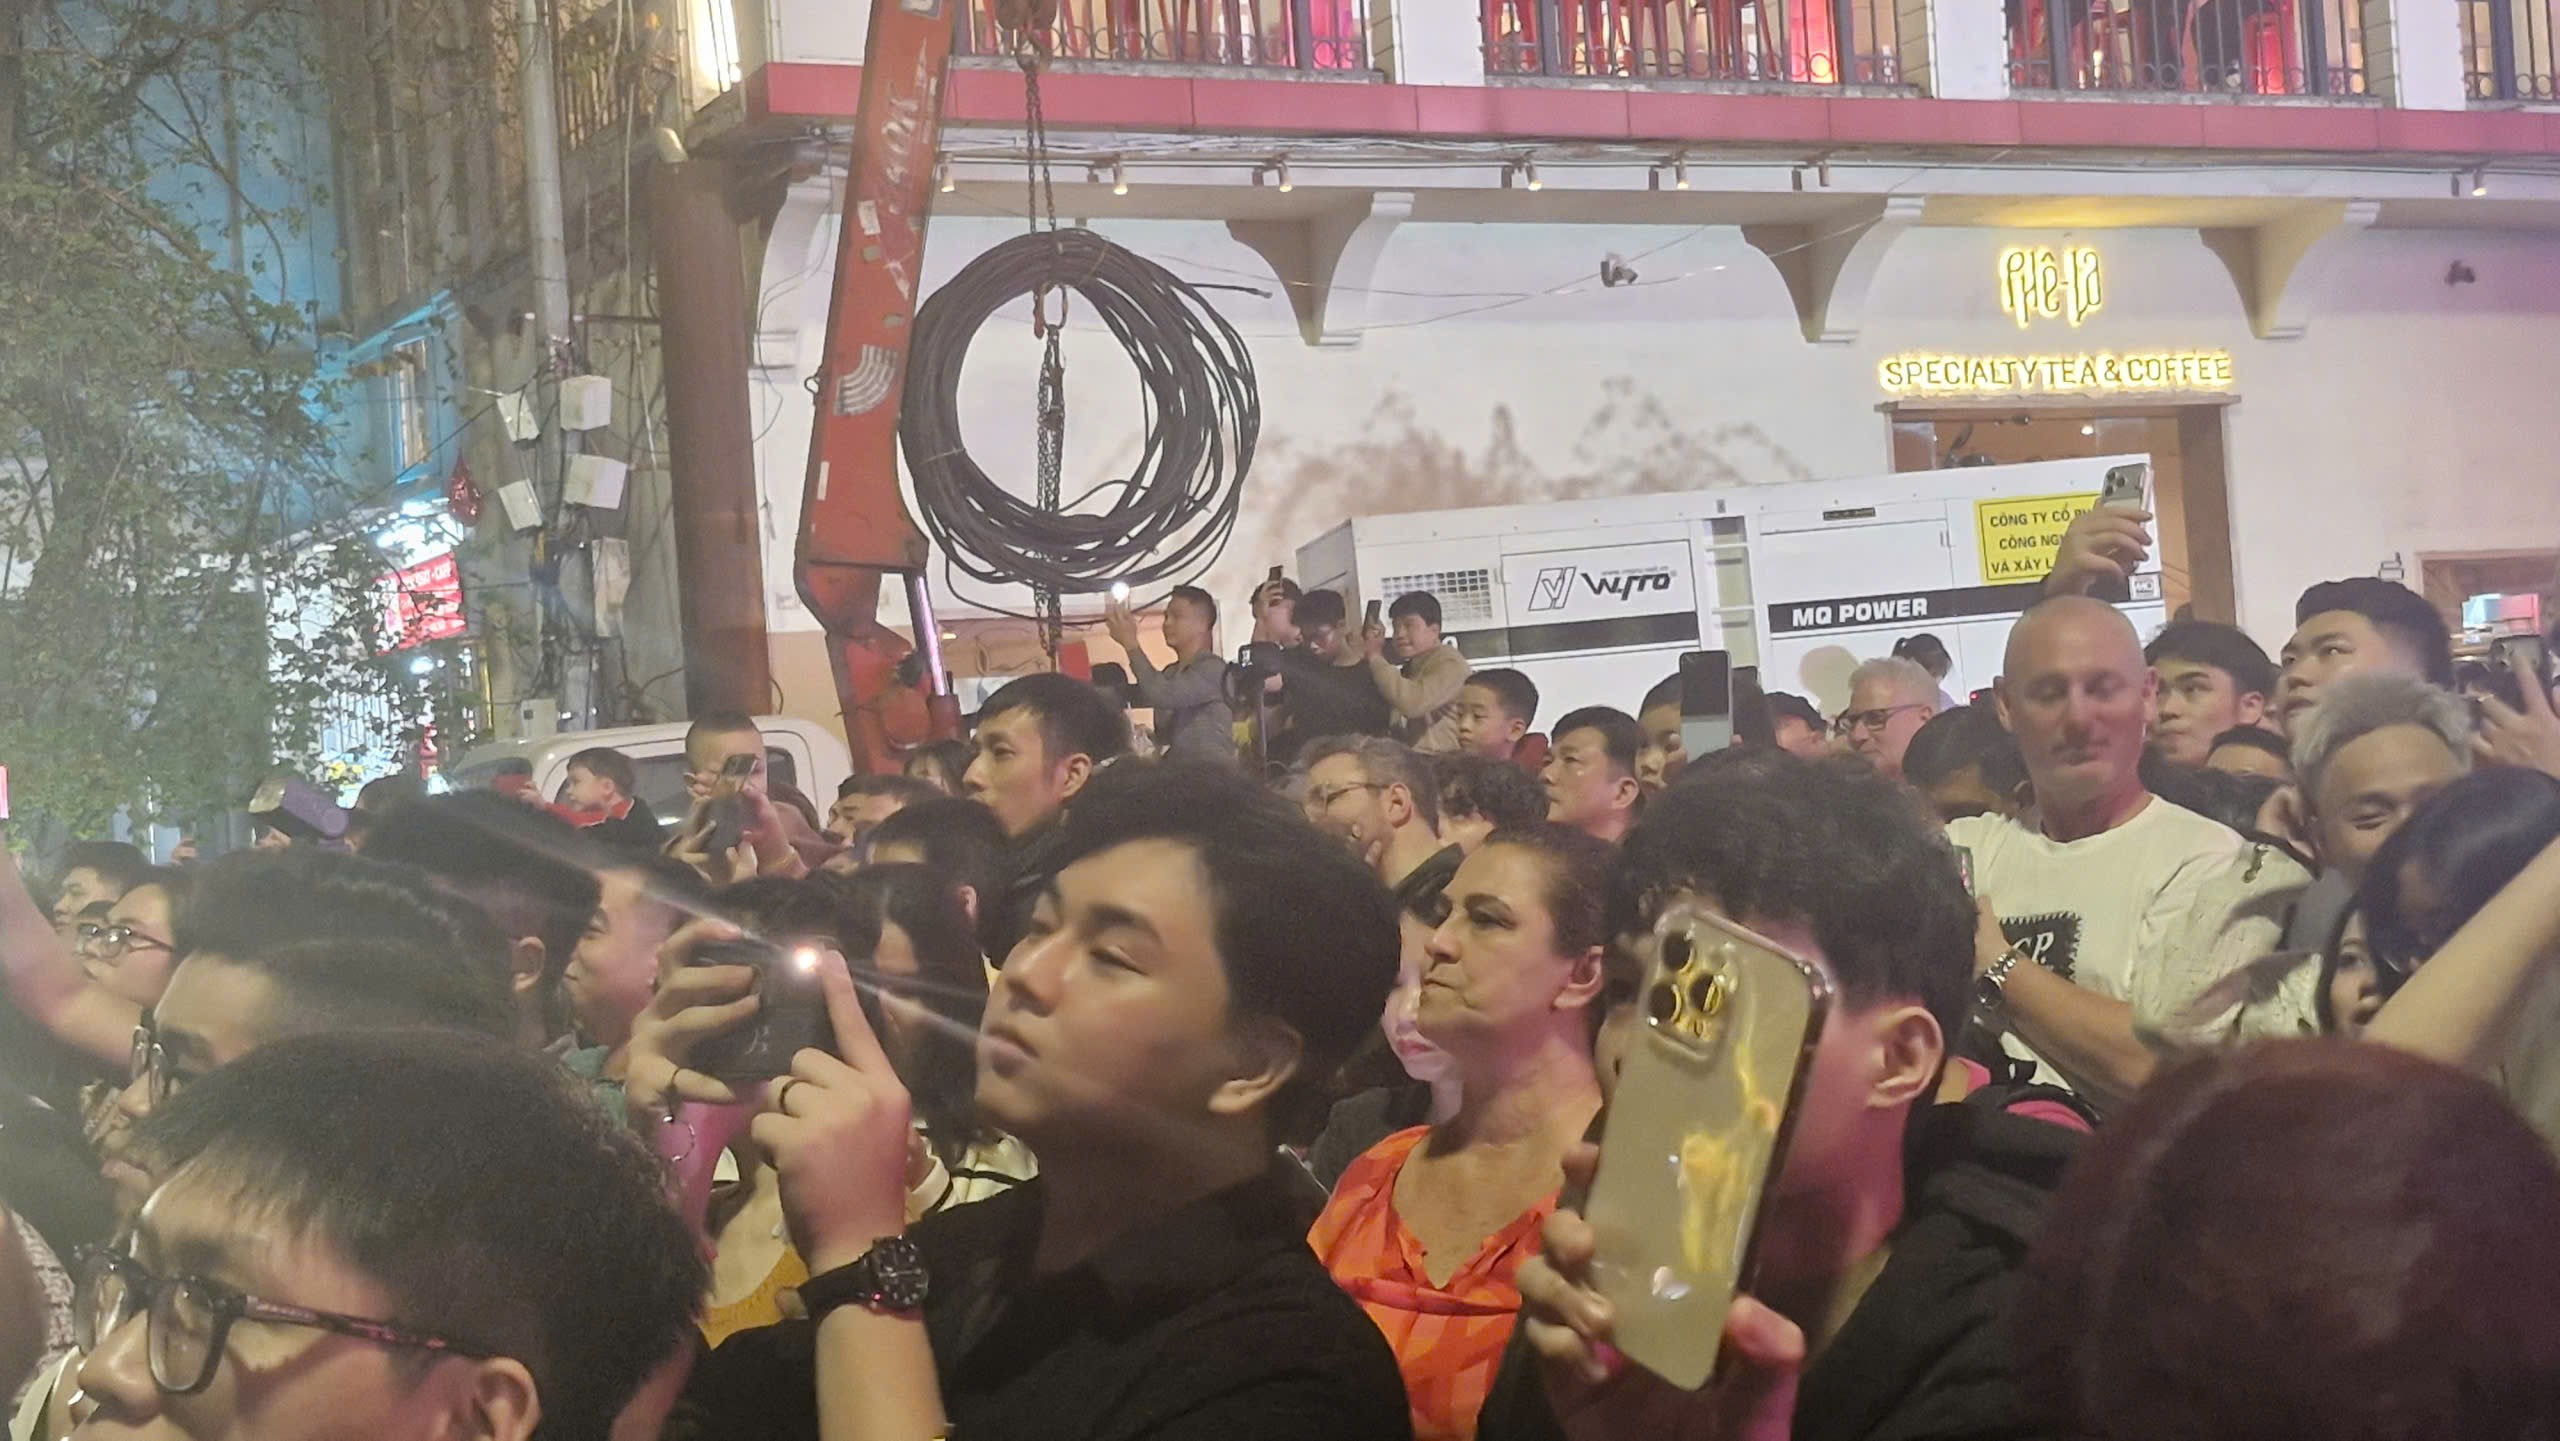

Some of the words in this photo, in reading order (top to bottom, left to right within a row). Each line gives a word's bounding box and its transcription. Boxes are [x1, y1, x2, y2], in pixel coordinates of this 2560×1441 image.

[1884, 357, 2038, 387] SPECIALTY
[2041, 357, 2097, 385] TEA
[2103, 357, 2122, 384] &
[2126, 356, 2233, 386] COFFEE
[1990, 511, 2028, 528] CÔNG
[2032, 511, 2048, 525] TY
[2052, 503, 2070, 522] CỔ
[1999, 534, 2037, 550] CÔNG
[2014, 556, 2041, 572] XÂY
[1792, 605, 1833, 627] MQ
[1839, 597, 1928, 623] POWER
